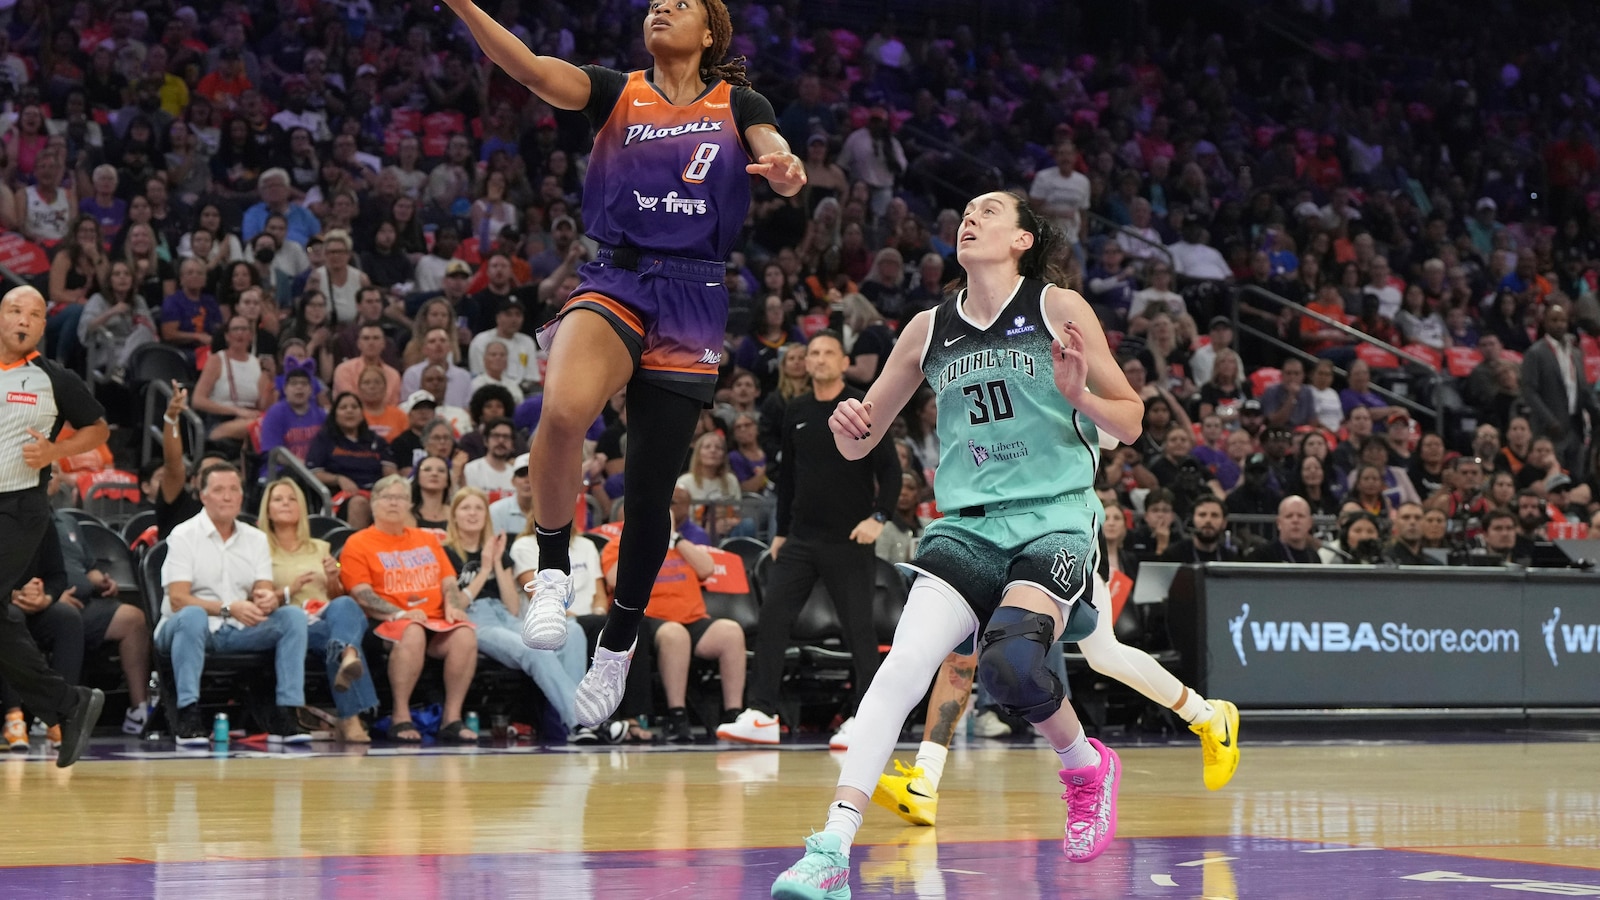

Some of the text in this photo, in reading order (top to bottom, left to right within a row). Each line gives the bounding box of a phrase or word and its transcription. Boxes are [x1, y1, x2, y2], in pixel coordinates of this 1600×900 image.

[624, 116, 723, 147] Phoenix
[681, 142, 720, 184] 8
[661, 191, 707, 216] fry's
[1006, 325, 1035, 336] BARCLAYS
[962, 378, 1015, 427] 30
[991, 439, 1026, 453] Liberty
[993, 448, 1029, 463] Mutual
[384, 565, 441, 595] ORANGE
[1250, 622, 1519, 652] WNBAStore.com
